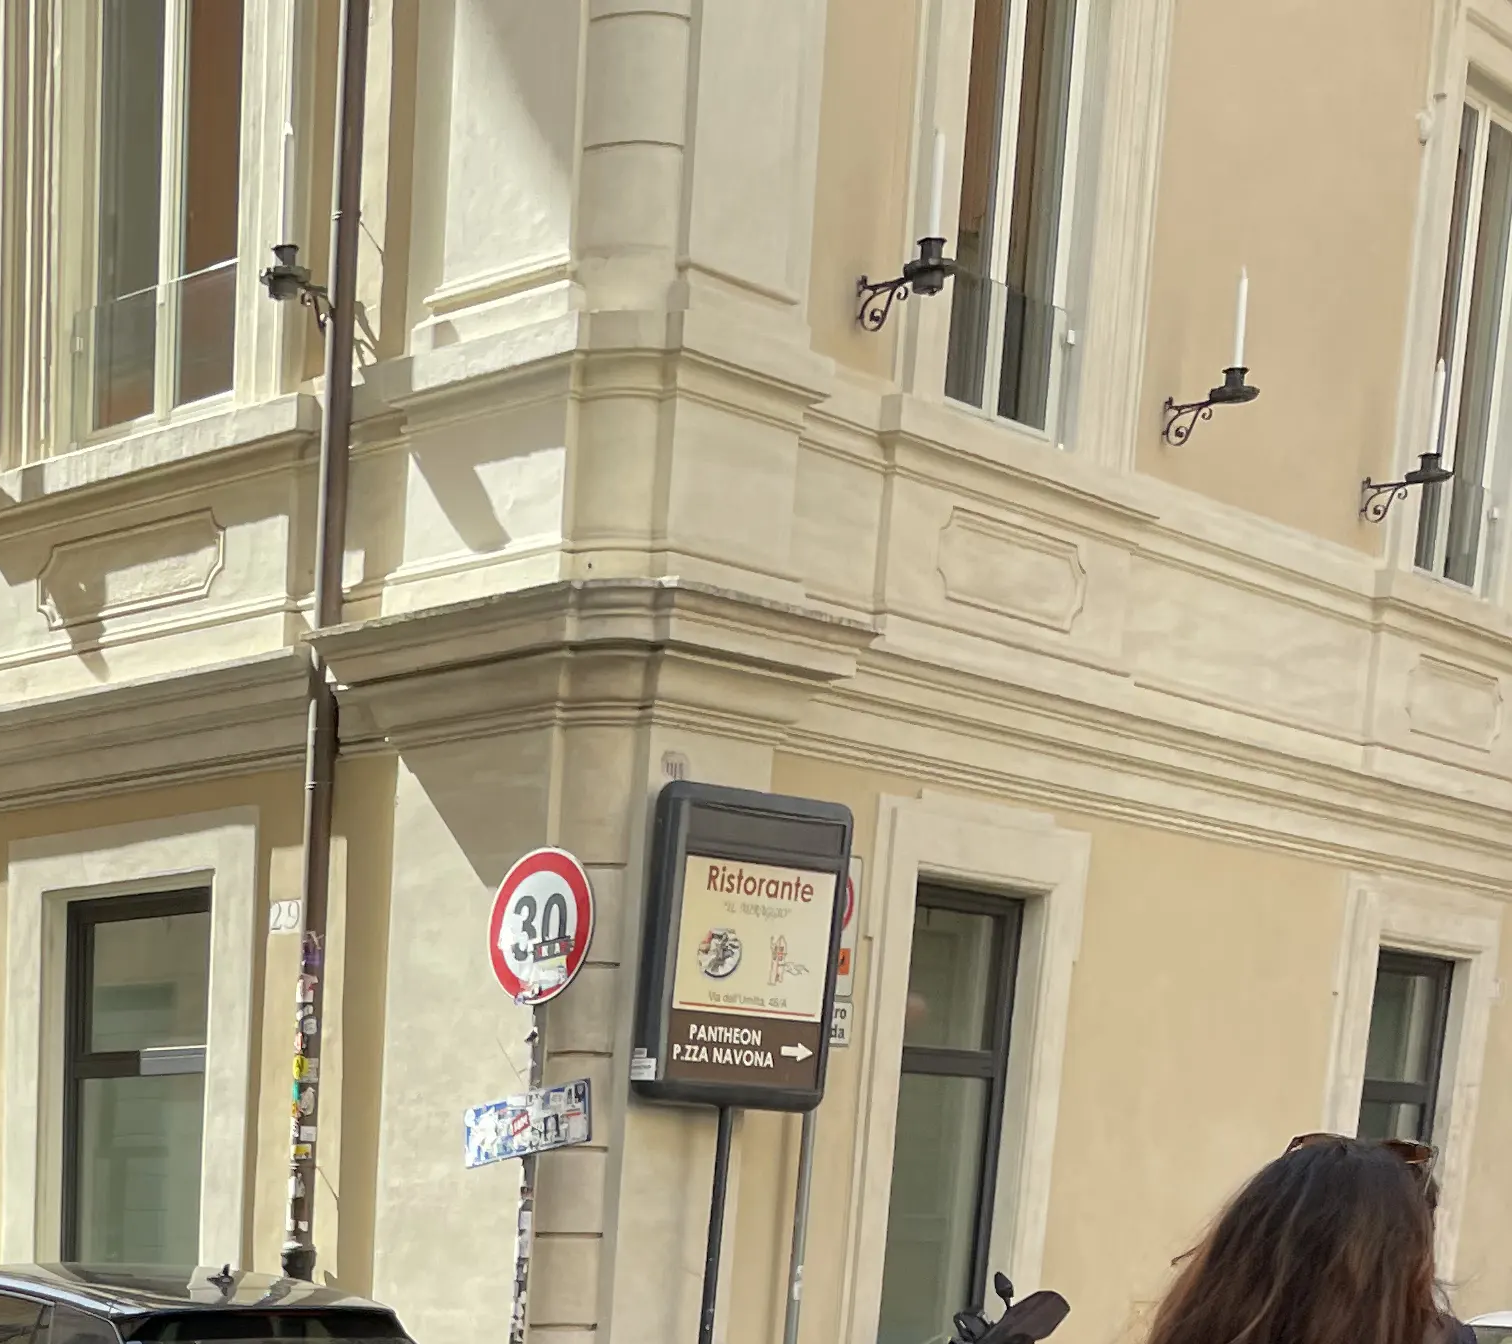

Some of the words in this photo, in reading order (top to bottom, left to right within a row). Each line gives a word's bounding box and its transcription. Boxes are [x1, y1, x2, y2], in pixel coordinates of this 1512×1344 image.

[706, 864, 815, 903] Ristorante
[271, 900, 300, 930] 29
[511, 893, 568, 961] 30
[689, 1023, 762, 1047] PANTHEON
[672, 1043, 709, 1063] P.ZZA
[712, 1046, 774, 1069] NAVONA
